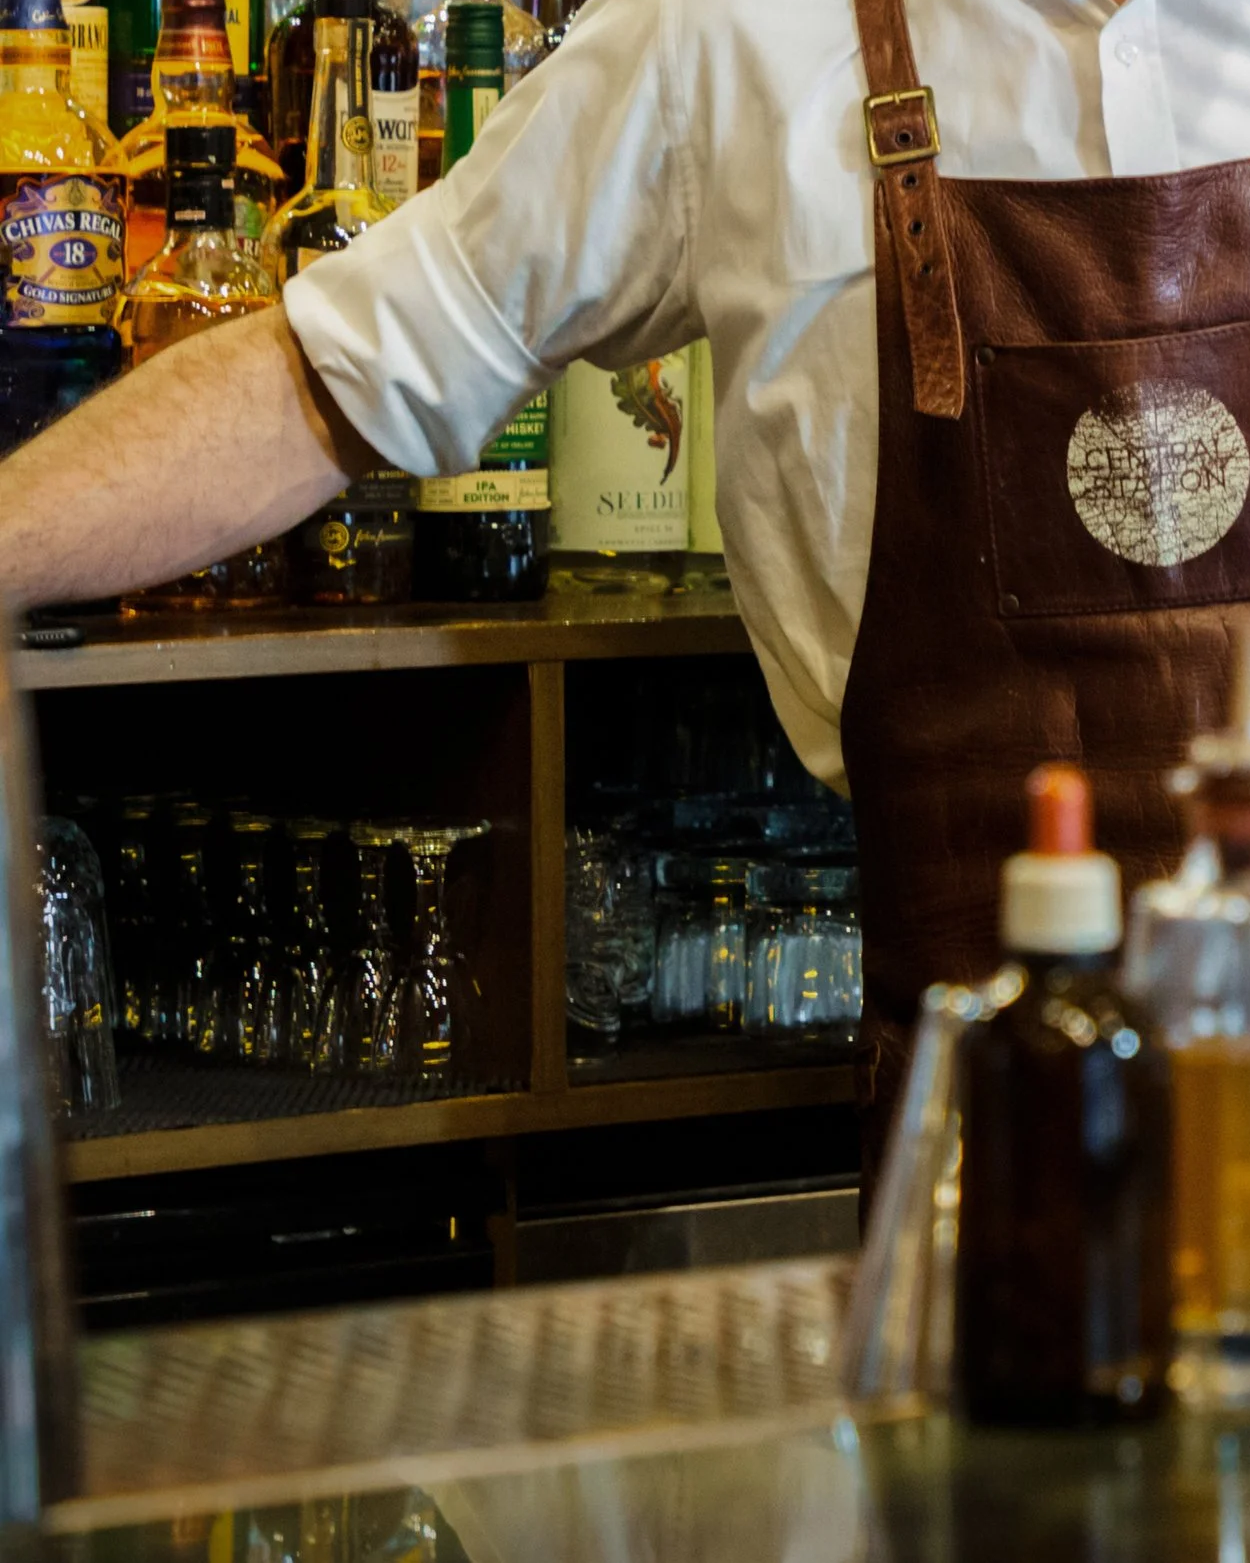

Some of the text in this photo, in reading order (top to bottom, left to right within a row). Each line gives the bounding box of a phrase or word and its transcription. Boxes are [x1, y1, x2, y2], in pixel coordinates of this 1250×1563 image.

[5, 211, 121, 243] CHIVAS REGAL
[63, 241, 86, 266] 18
[23, 284, 114, 305] GOLD SIGNATURE
[475, 481, 497, 492] IPA
[463, 492, 510, 504] EDITION
